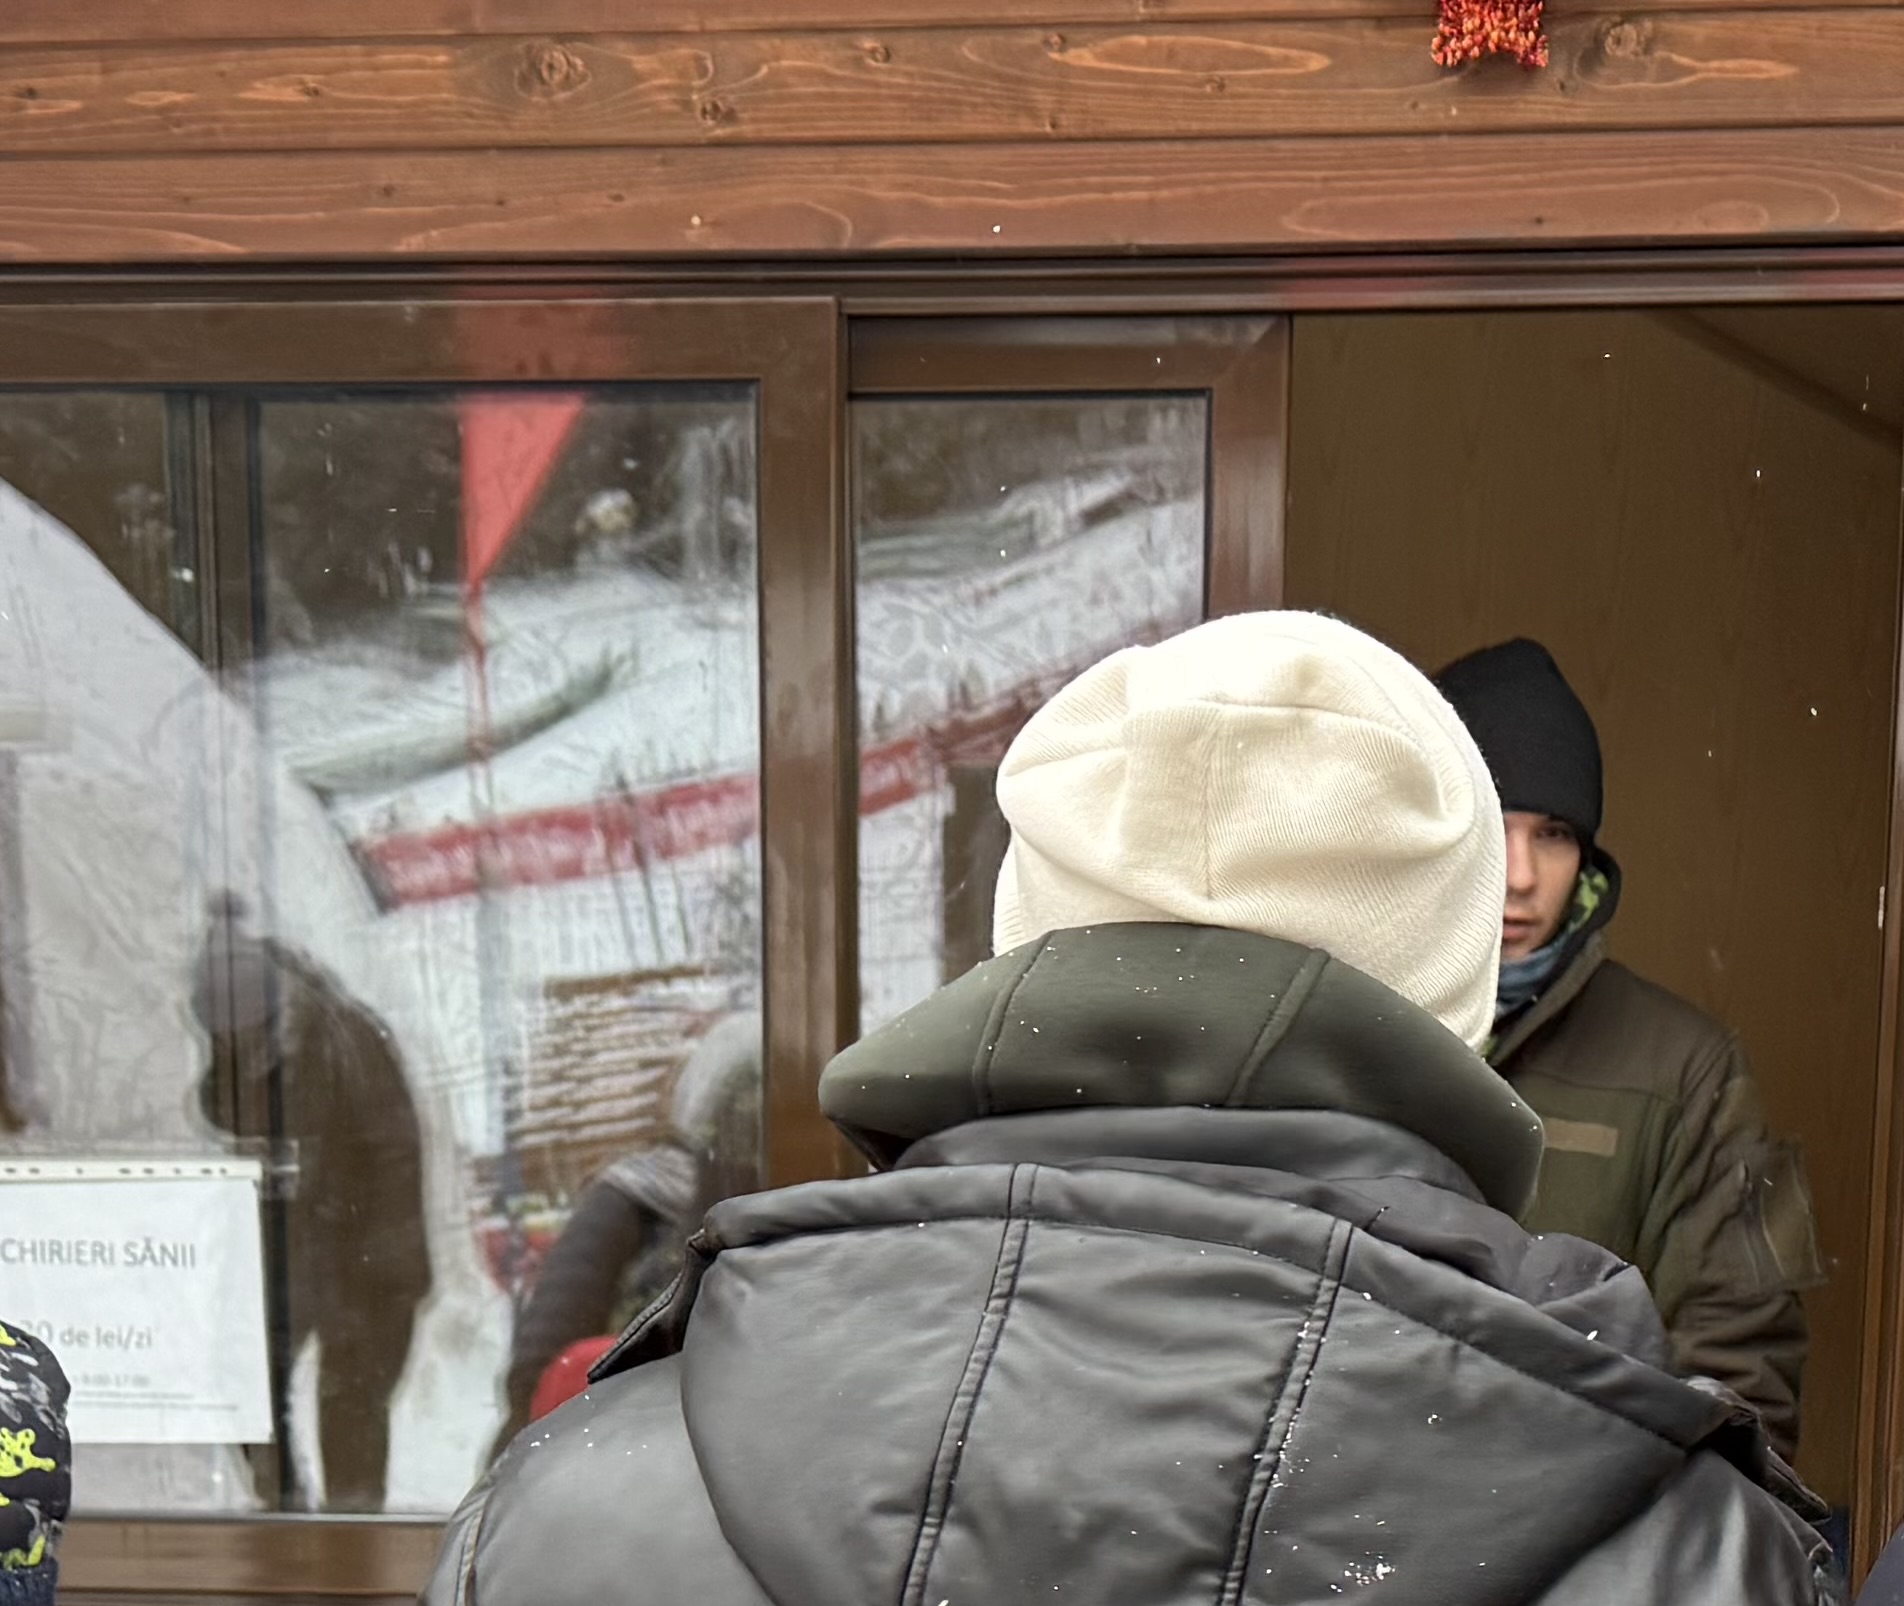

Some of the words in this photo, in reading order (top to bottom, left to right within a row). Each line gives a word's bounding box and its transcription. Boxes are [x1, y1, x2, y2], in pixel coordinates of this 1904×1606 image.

[123, 1237, 197, 1270] SĂNII
[59, 1322, 91, 1348] de
[95, 1323, 153, 1351] lei/zi
